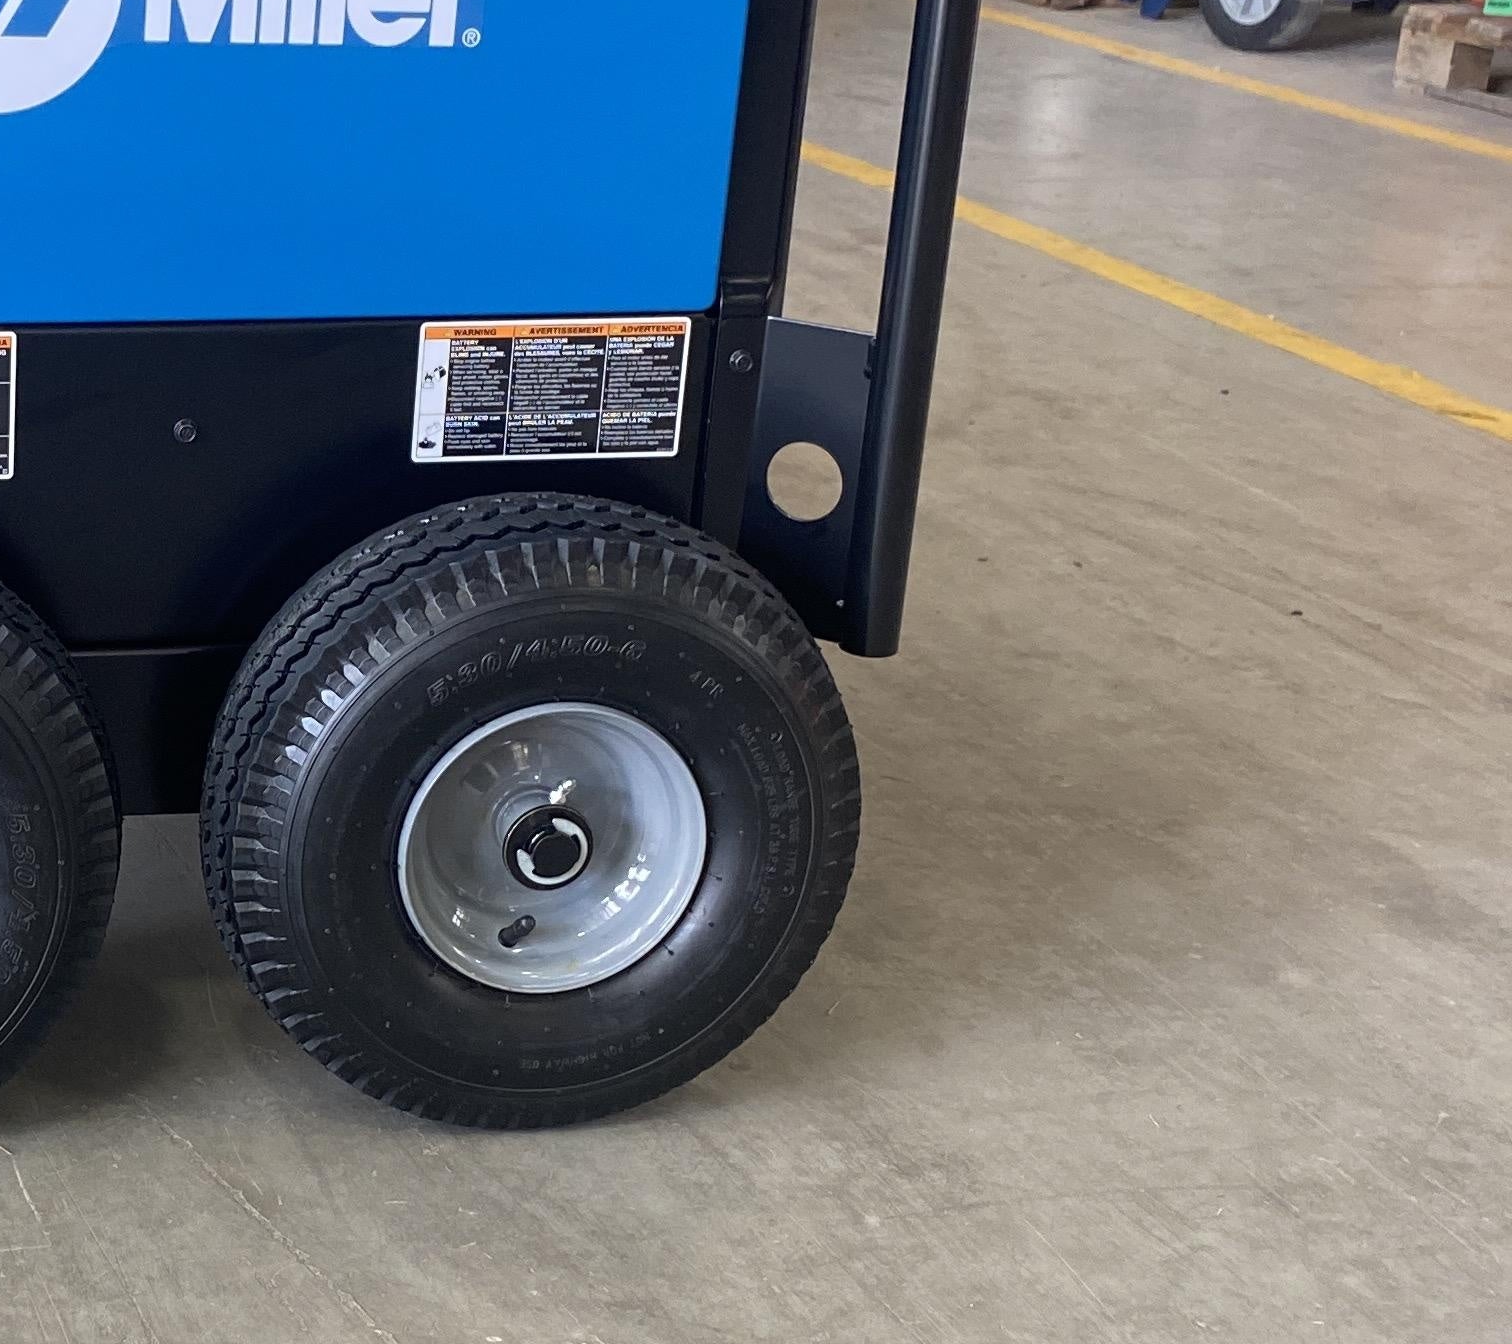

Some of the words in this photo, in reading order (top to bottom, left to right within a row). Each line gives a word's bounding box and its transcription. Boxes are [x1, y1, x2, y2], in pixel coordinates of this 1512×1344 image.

[453, 328, 497, 336] WARNING
[528, 326, 604, 335] AVERTISSEMENT
[620, 325, 684, 333] ADVERTENCIA
[426, 634, 646, 706] 5.30/4.50-6
